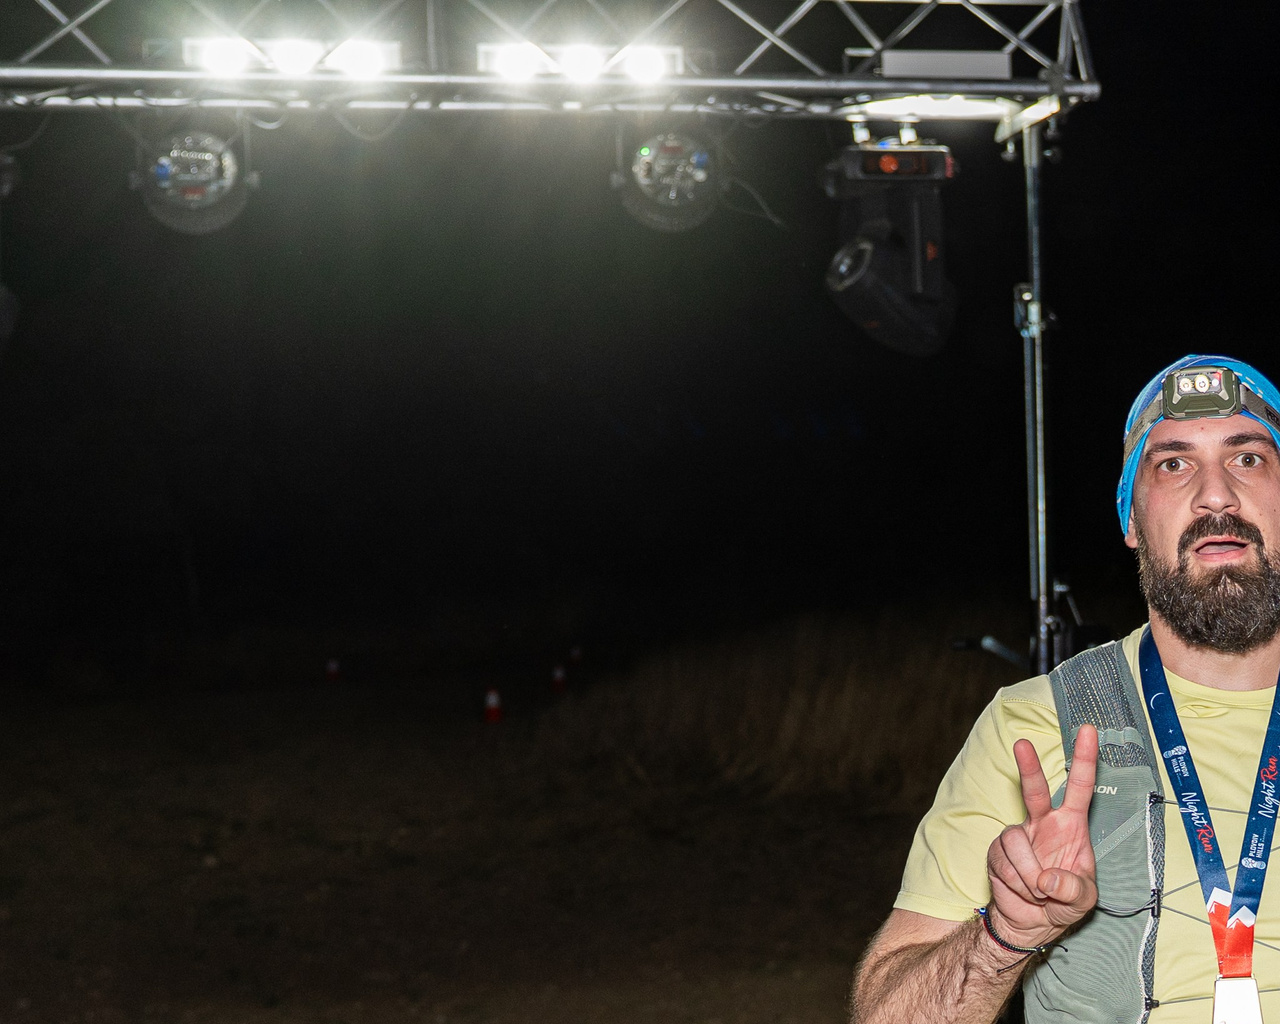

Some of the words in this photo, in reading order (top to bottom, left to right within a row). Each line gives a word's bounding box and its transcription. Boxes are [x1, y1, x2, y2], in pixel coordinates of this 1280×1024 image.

[1178, 756, 1190, 777] PLOVDIV
[1260, 756, 1279, 782] Run
[1258, 781, 1280, 818] Night
[1180, 792, 1207, 827] Night
[1196, 824, 1214, 854] Run
[1248, 833, 1259, 857] PLOVDIV
